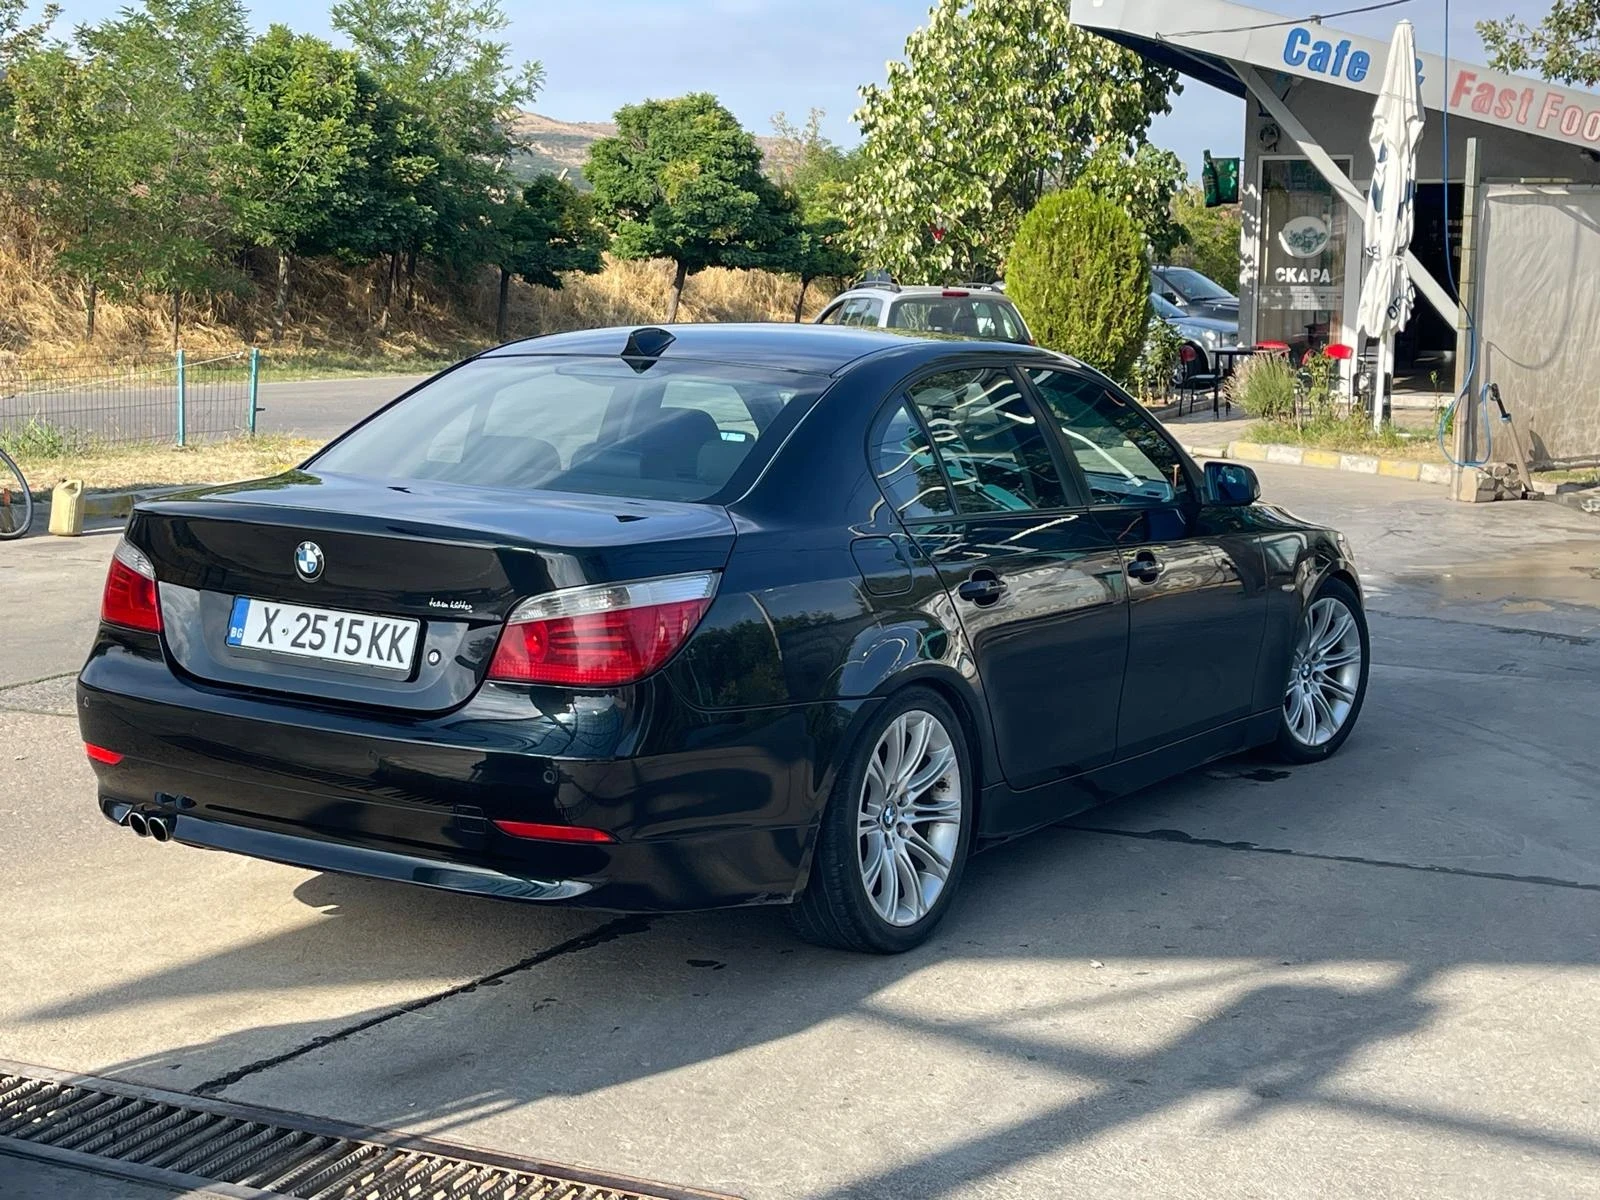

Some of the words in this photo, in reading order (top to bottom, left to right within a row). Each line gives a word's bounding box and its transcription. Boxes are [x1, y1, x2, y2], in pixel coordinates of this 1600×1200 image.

[1283, 27, 1370, 82] Cafe
[1449, 70, 1534, 125] Fast
[1275, 267, 1330, 283] СКАРА
[230, 626, 243, 638] BG
